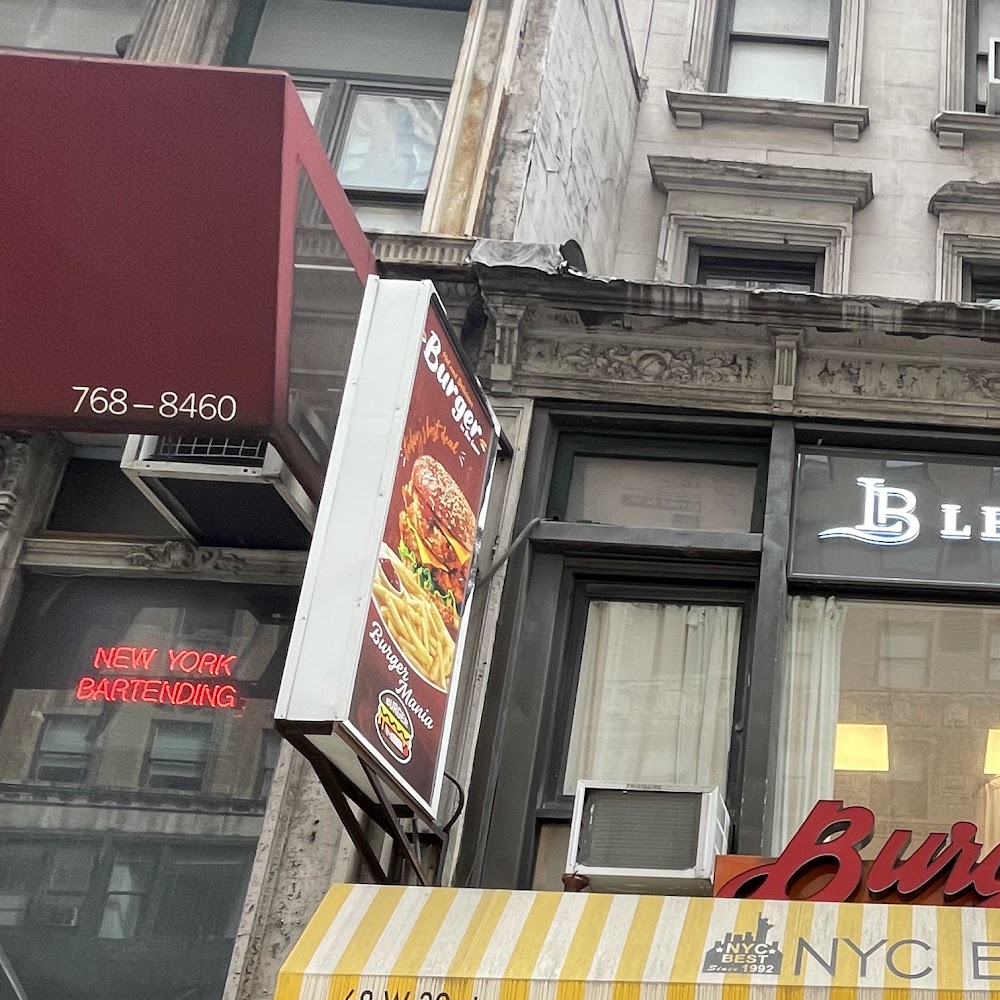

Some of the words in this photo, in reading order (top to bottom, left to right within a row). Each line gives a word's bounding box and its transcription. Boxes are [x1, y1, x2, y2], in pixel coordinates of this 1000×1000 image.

[423, 329, 483, 437] Burger
[94, 646, 157, 670] NEW
[168, 650, 237, 676] YORK
[369, 620, 410, 682] Burger
[76, 677, 237, 708] BARTENDING
[395, 680, 434, 730] Mania
[721, 954, 769, 964] BEST
[726, 943, 769, 954] NYC
[794, 937, 932, 980] NYC
[742, 964, 774, 973] 1992
